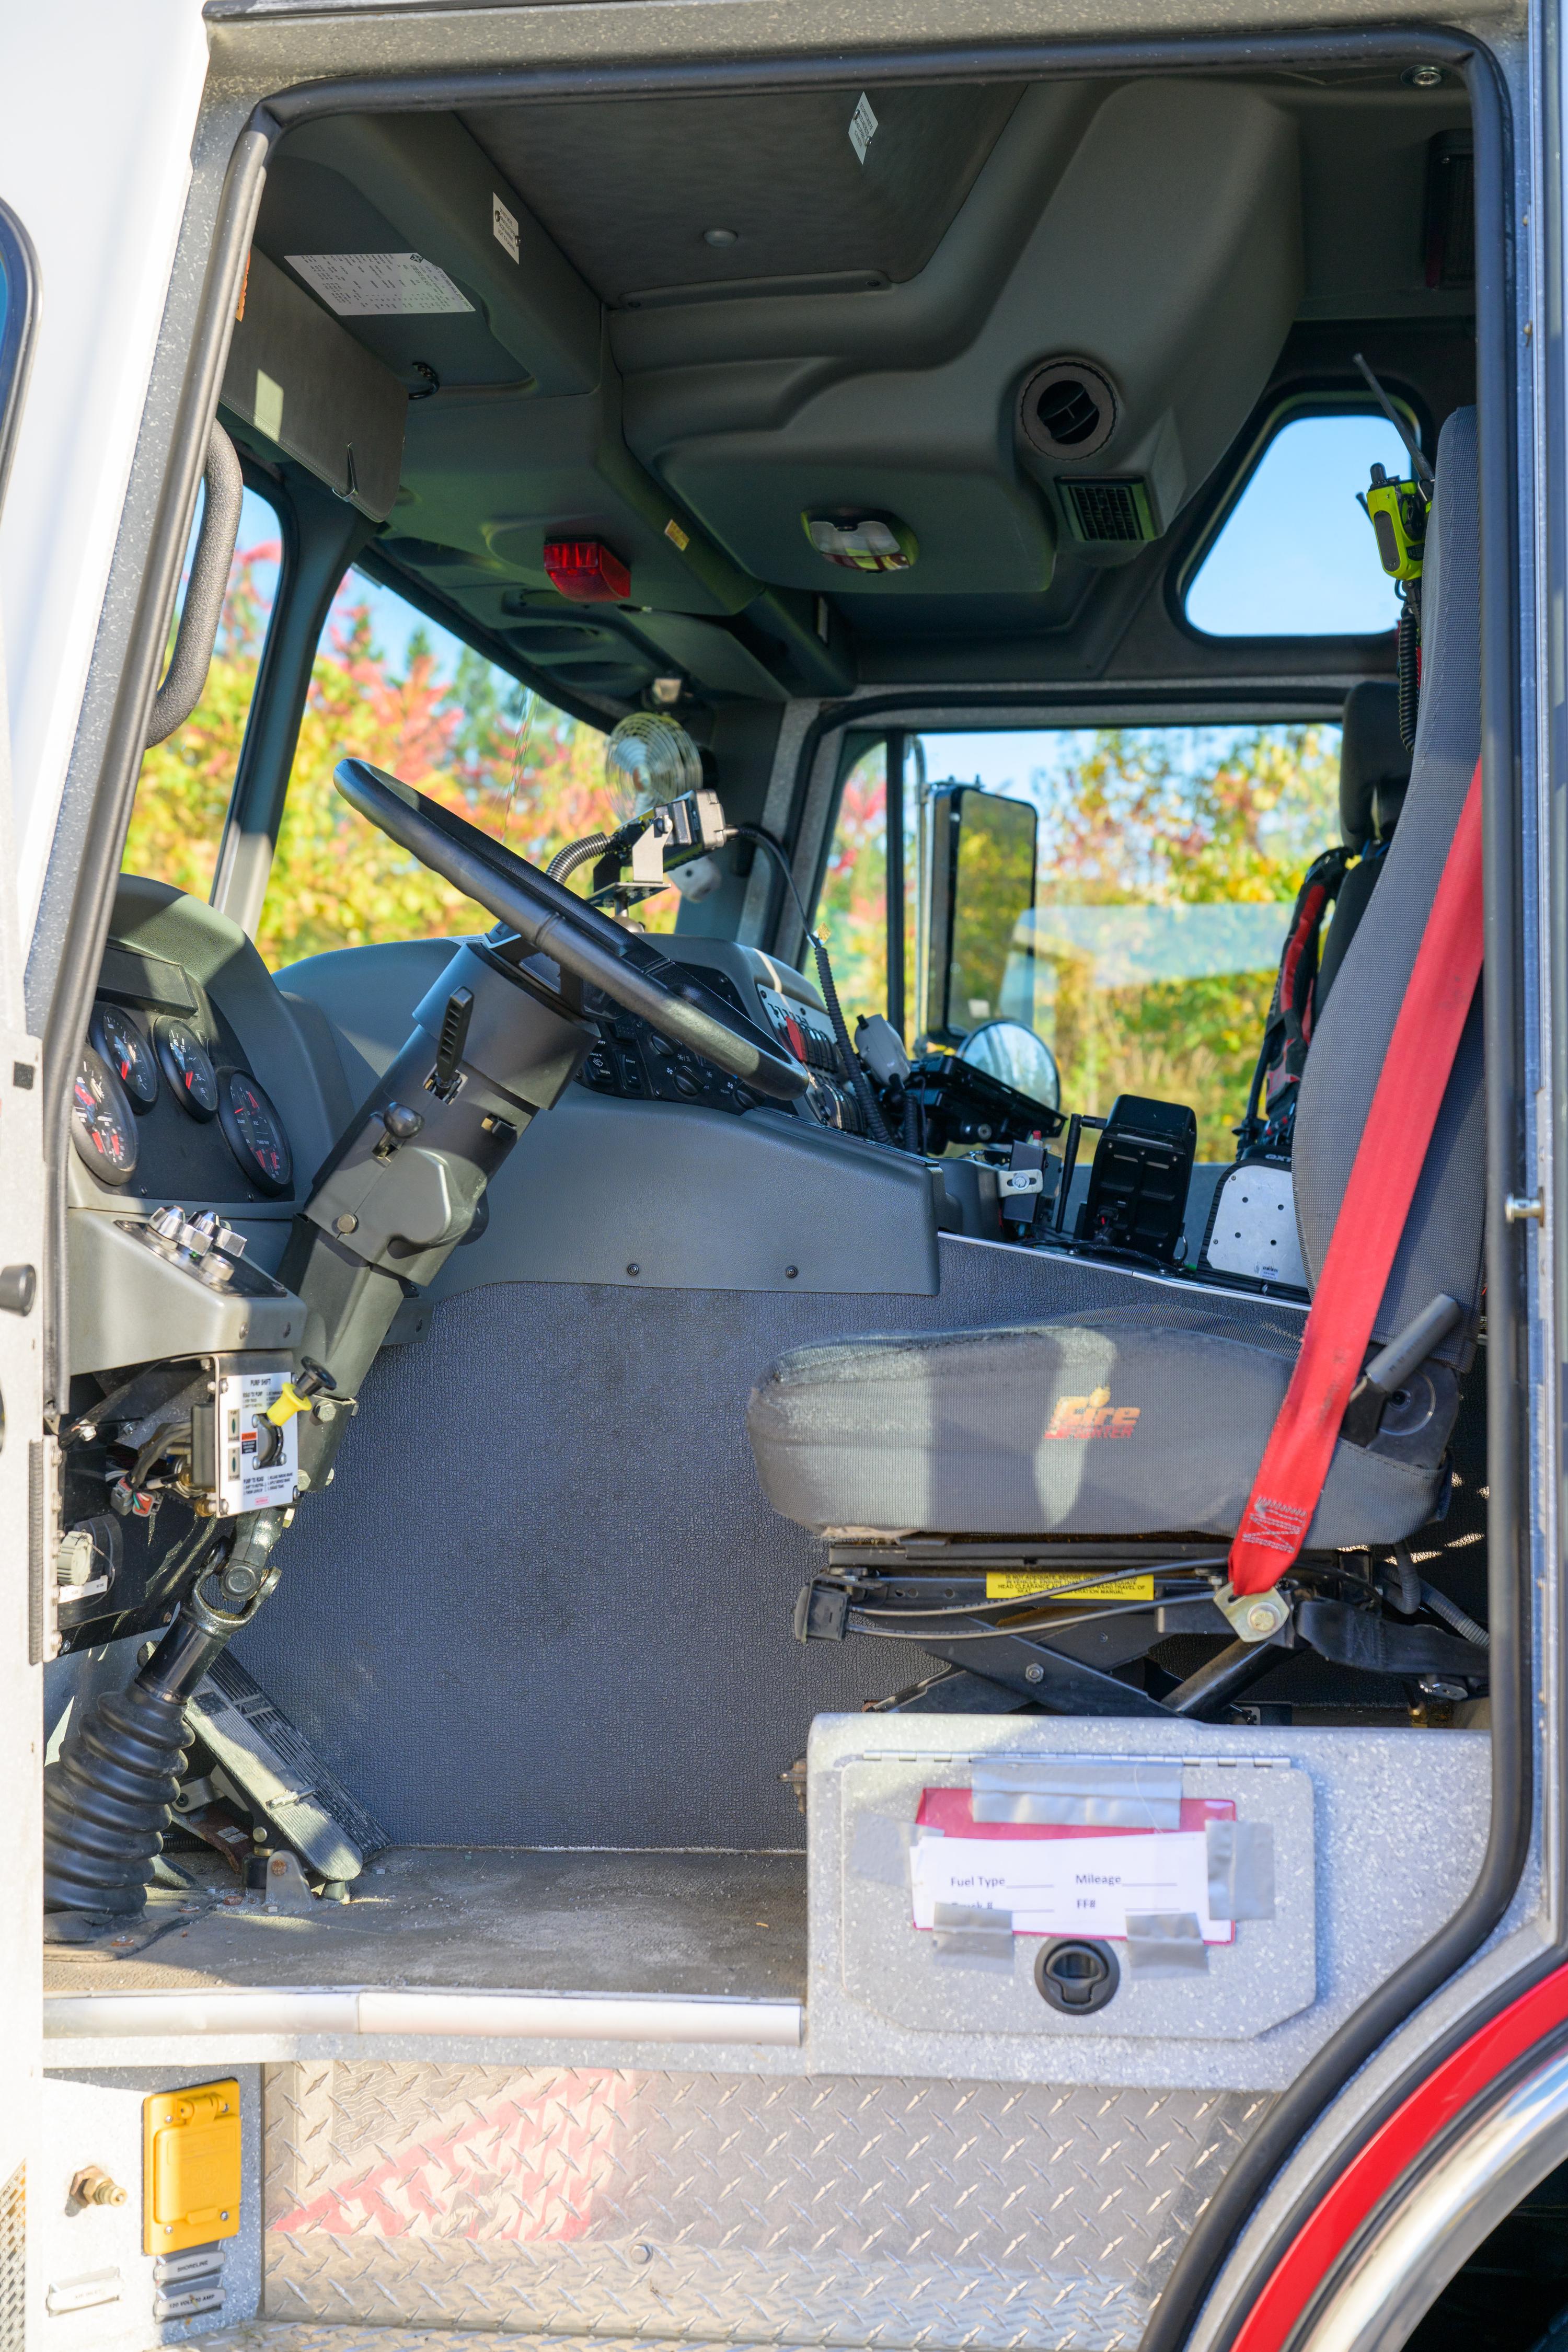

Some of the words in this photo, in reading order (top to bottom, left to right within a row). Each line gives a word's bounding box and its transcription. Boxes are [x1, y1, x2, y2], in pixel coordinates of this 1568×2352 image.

[951, 1876, 974, 1886] Fuel
[978, 1876, 1006, 1888] Type
[1076, 1873, 1121, 1886] Mileage
[1077, 1899, 1096, 1909] FF#
[178, 2260, 209, 2272] SHORELINE
